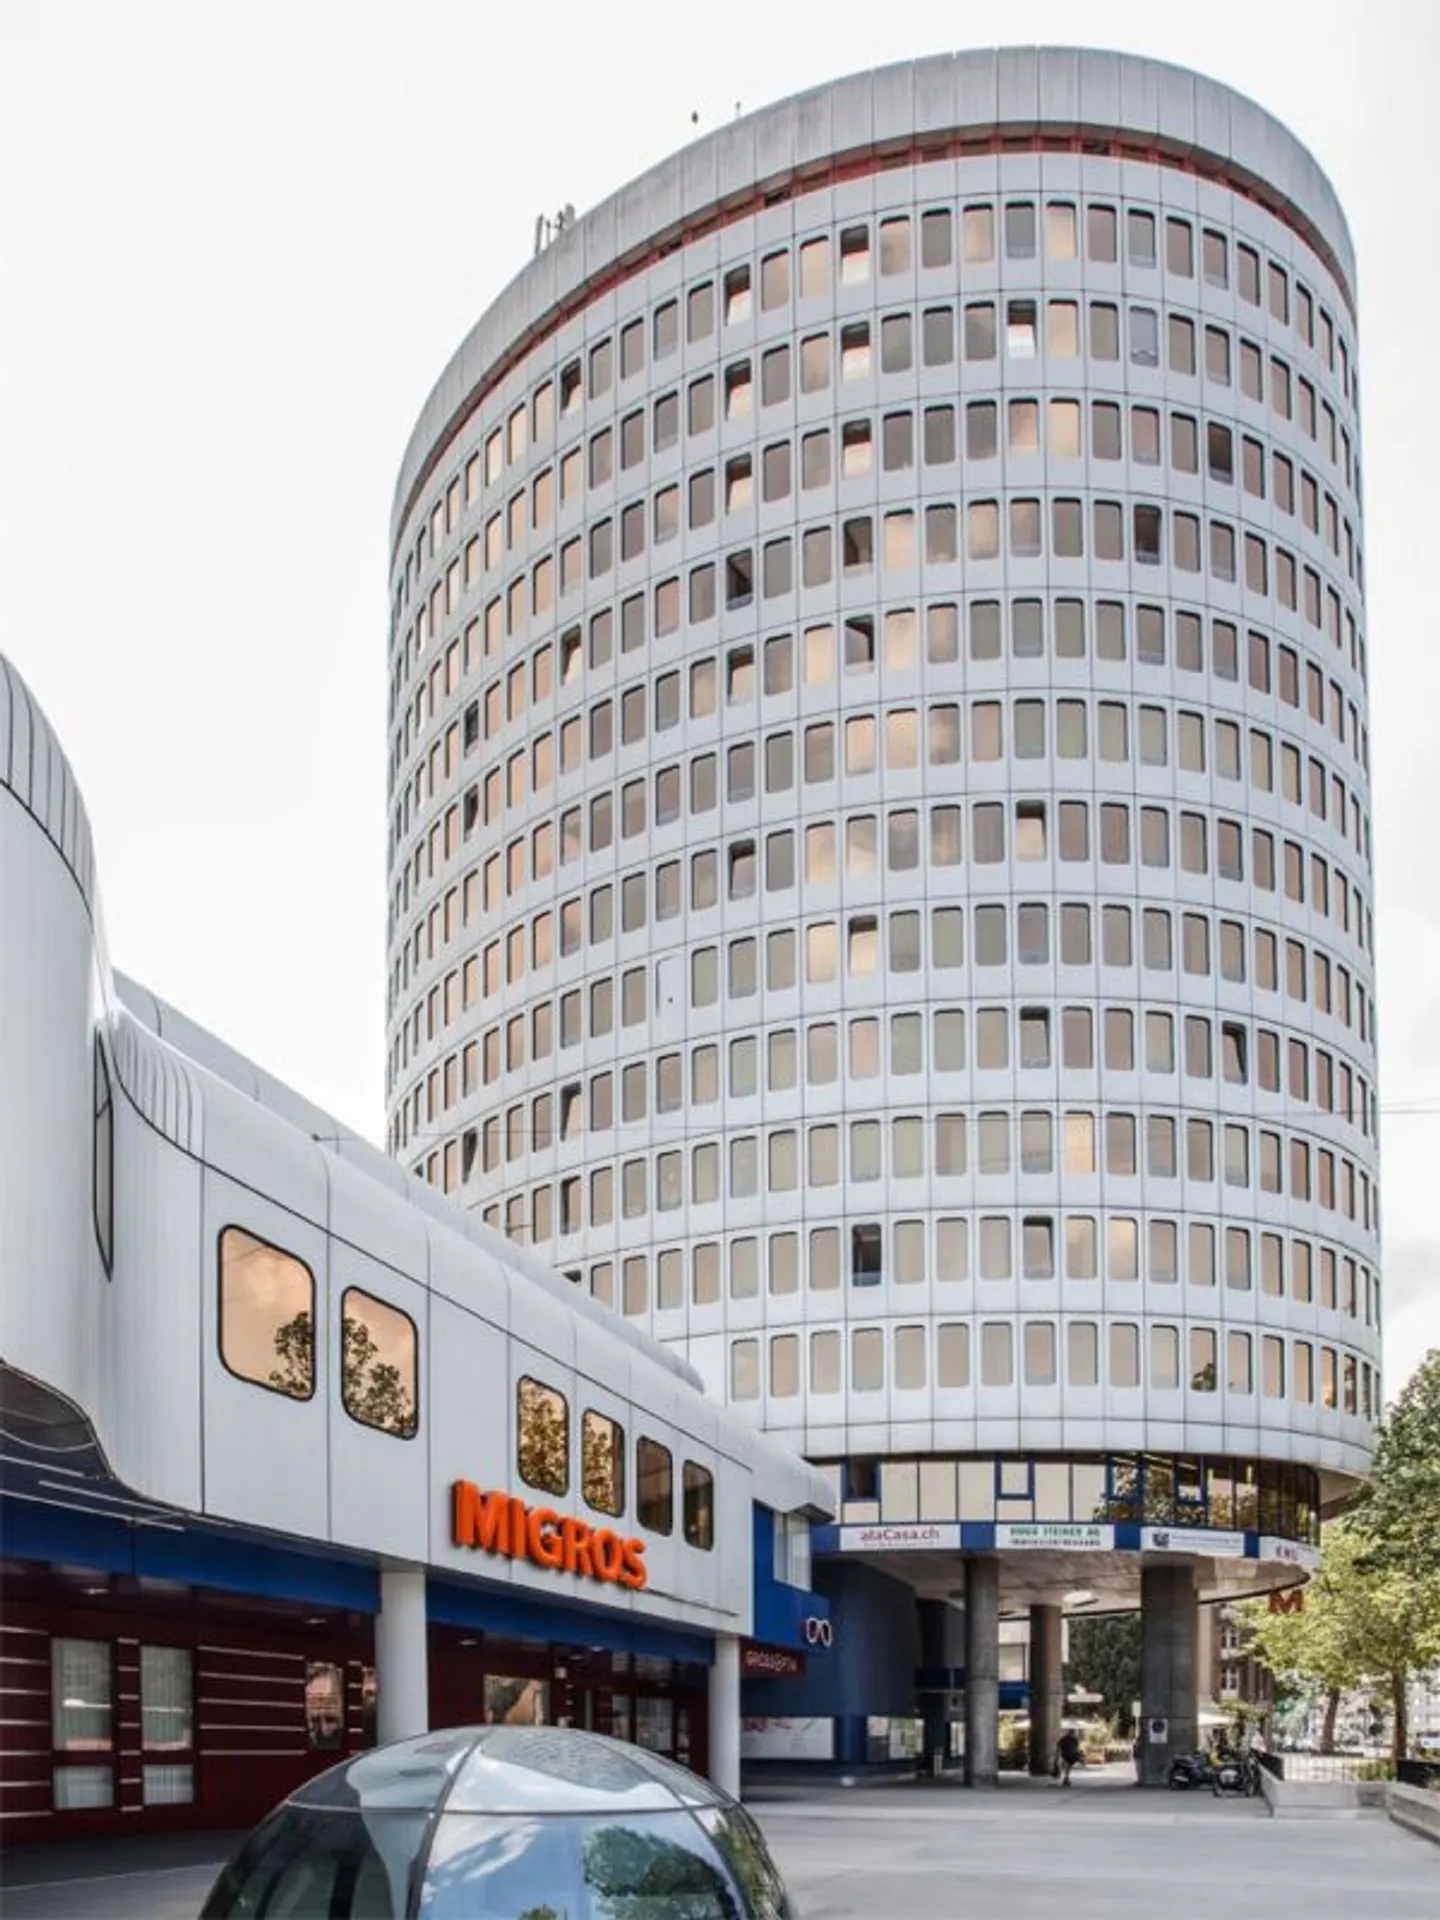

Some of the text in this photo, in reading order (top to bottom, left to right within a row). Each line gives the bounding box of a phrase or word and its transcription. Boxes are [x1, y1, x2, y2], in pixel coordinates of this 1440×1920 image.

[453, 1480, 646, 1590] MIGROS
[860, 1526, 940, 1541] alaCasa.ch
[1269, 1589, 1304, 1613] M
